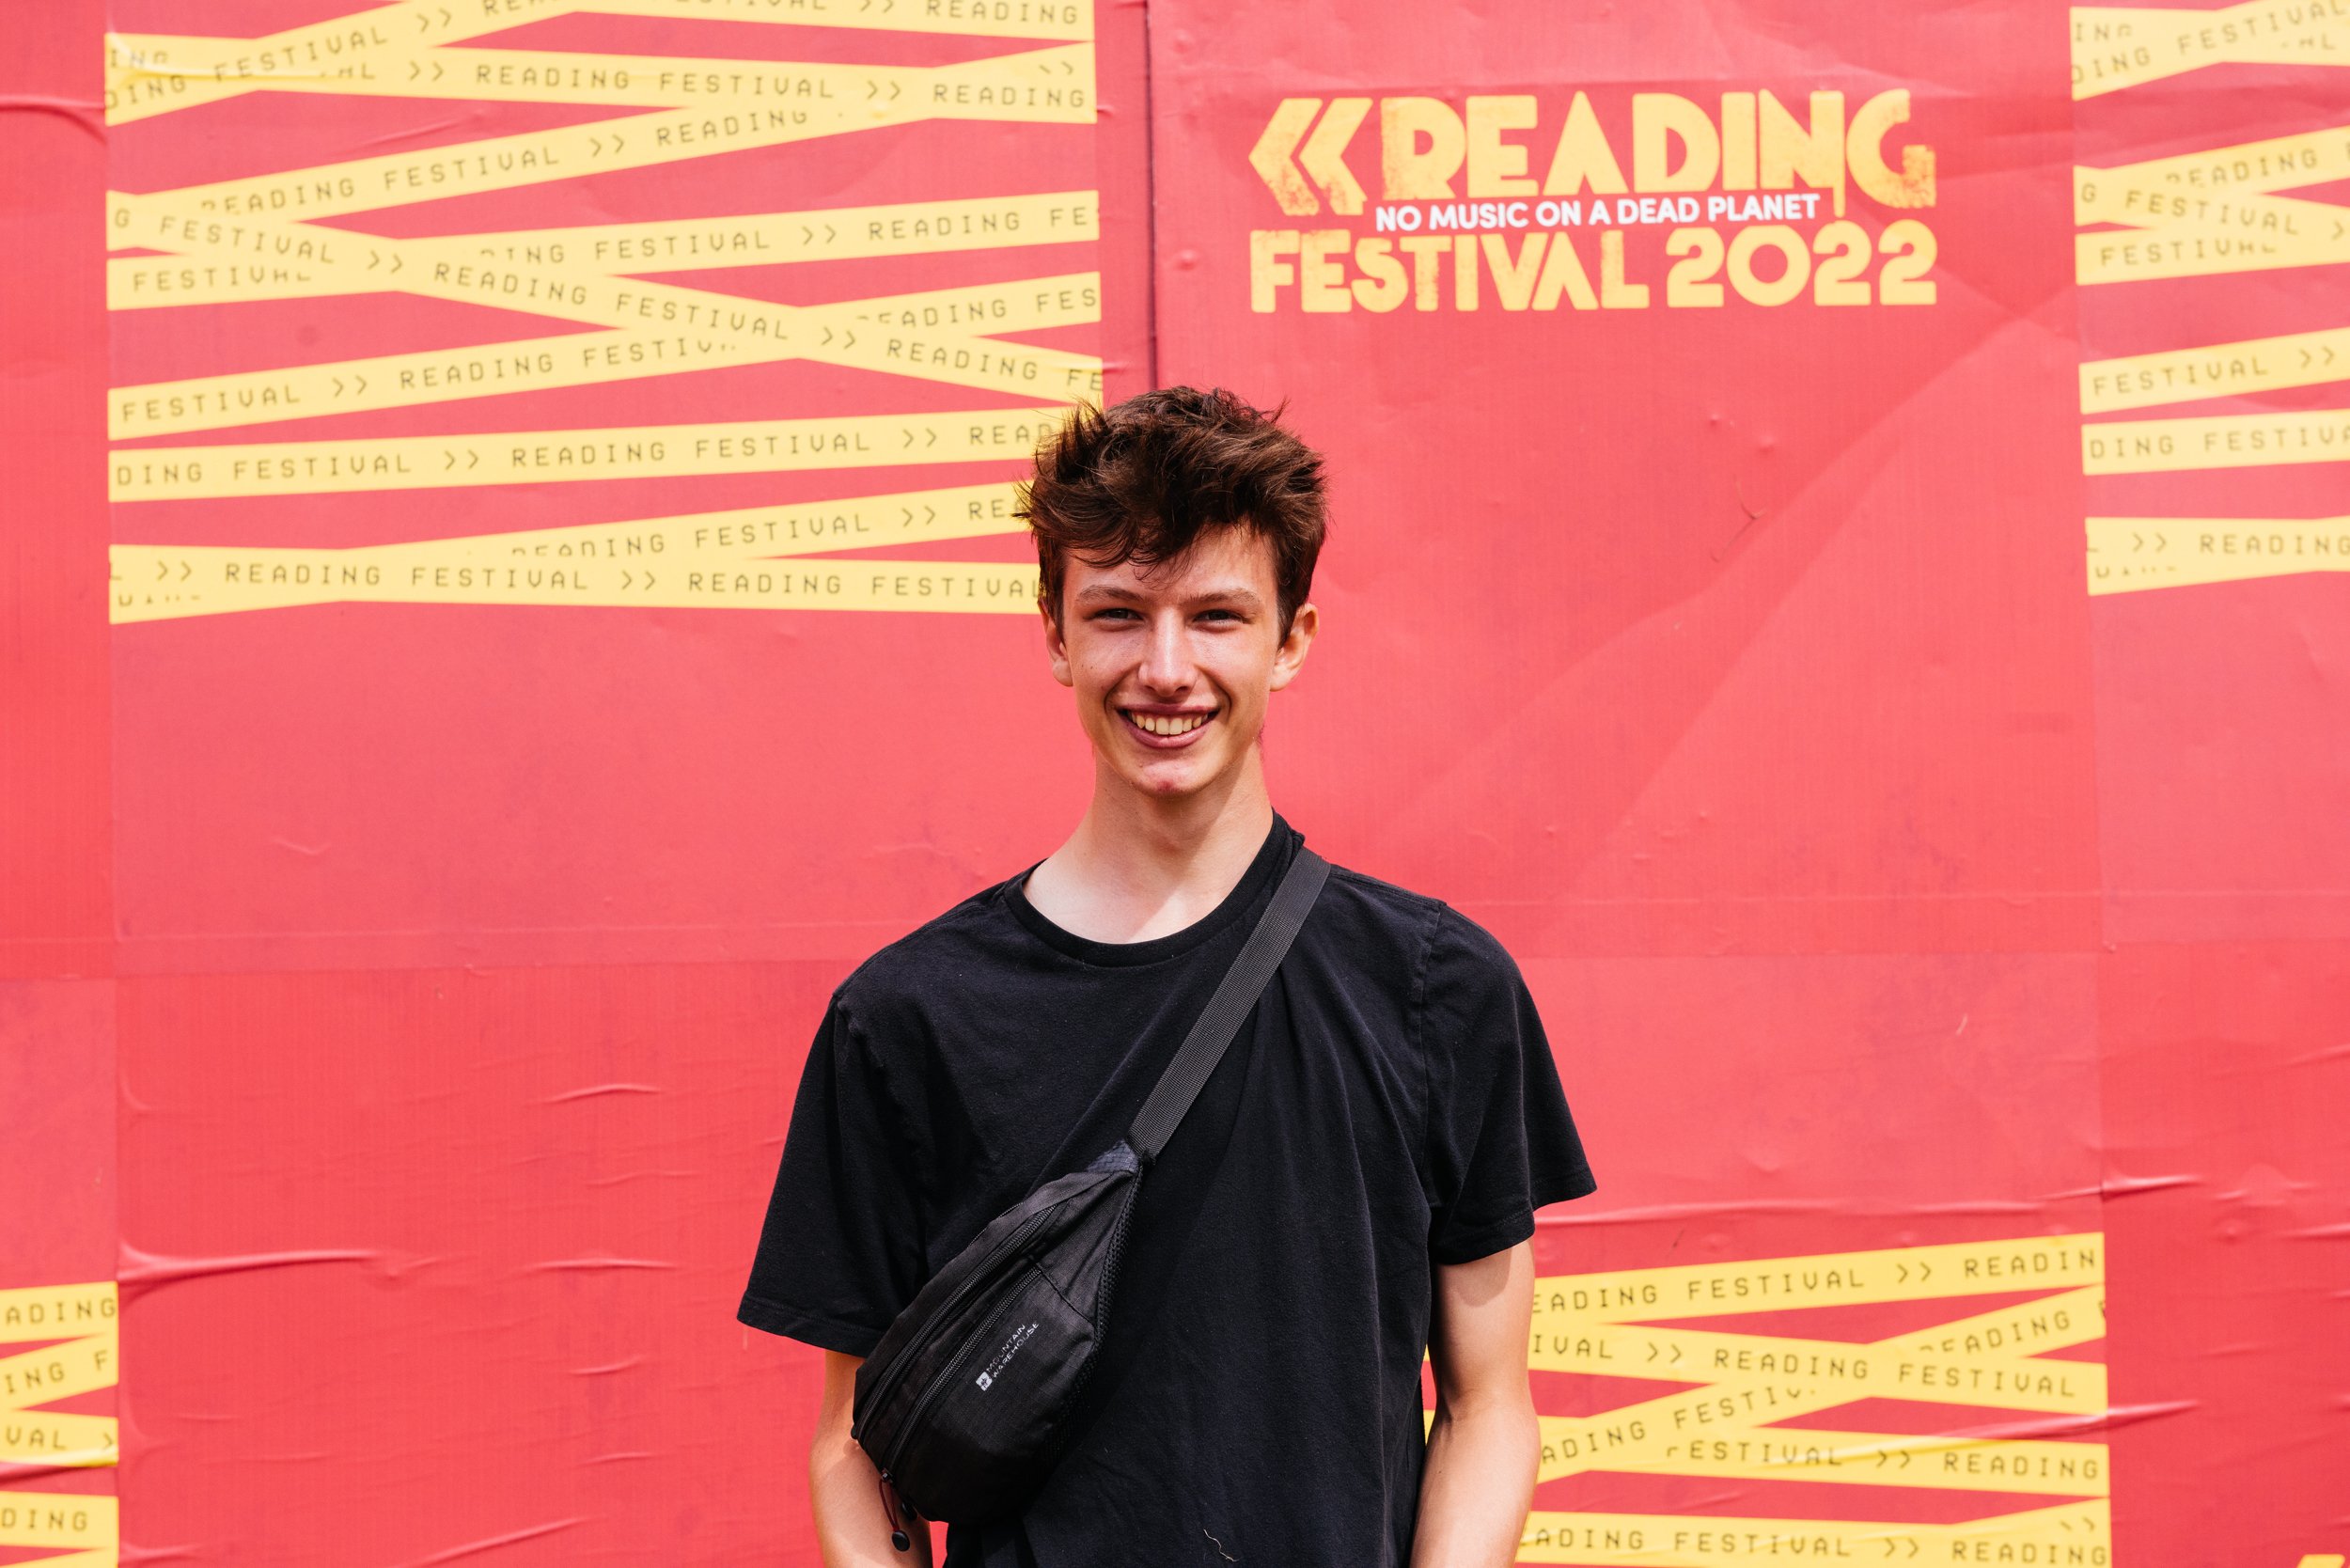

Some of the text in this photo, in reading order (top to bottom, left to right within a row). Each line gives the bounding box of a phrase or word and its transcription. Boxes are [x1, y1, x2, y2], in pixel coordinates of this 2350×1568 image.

[928, 1, 1079, 24] READING
[2176, 0, 2348, 55] FESTIVAL
[213, 26, 388, 83] FESTIVAL
[477, 65, 1086, 108] READING FESTIVAL READING
[384, 145, 559, 191] FESTIVAL
[1381, 88, 1937, 217] READING
[1375, 193, 1821, 232] NO MUSIC ON A DEAD PLANET
[2125, 189, 2299, 236] FESTIVAL
[595, 231, 770, 261] FESTIVAL
[870, 212, 1021, 241] READING
[1250, 219, 1938, 313] FESTIVAL 2022
[161, 215, 336, 264] FESTIVAL
[434, 262, 588, 306] READING
[616, 292, 788, 340] FESTIVAL
[887, 338, 1038, 381] READING
[856, 299, 1007, 328] ADING
[123, 385, 301, 422] FESTIVAL
[400, 353, 554, 391] READING
[2092, 356, 2268, 396] FESTIVAL
[118, 463, 203, 486] DING
[234, 455, 411, 480] FESTIVAL
[512, 443, 666, 468] READING
[697, 433, 871, 459] FESTIVAL
[2089, 435, 2175, 460] DING
[696, 513, 870, 549] FESTIVAL
[2200, 533, 2350, 557] READING
[226, 564, 382, 586] READING
[412, 566, 588, 590] FESTIVAL
[689, 572, 842, 595] READING
[1688, 1269, 1865, 1301] FESTIVAL
[1965, 1248, 2096, 1278] READIN
[986, 1324, 1026, 1372] MOUNTAIN
[993, 1321, 1039, 1378] WAREHOUSE
[1919, 1310, 2071, 1354] ADING
[1714, 1348, 1869, 1380] READING
[1898, 1363, 2076, 1398] FESTIVAL
[1943, 1452, 2099, 1480] READING
[1521, 1528, 2107, 1567] ADING FESTIVAL READING
